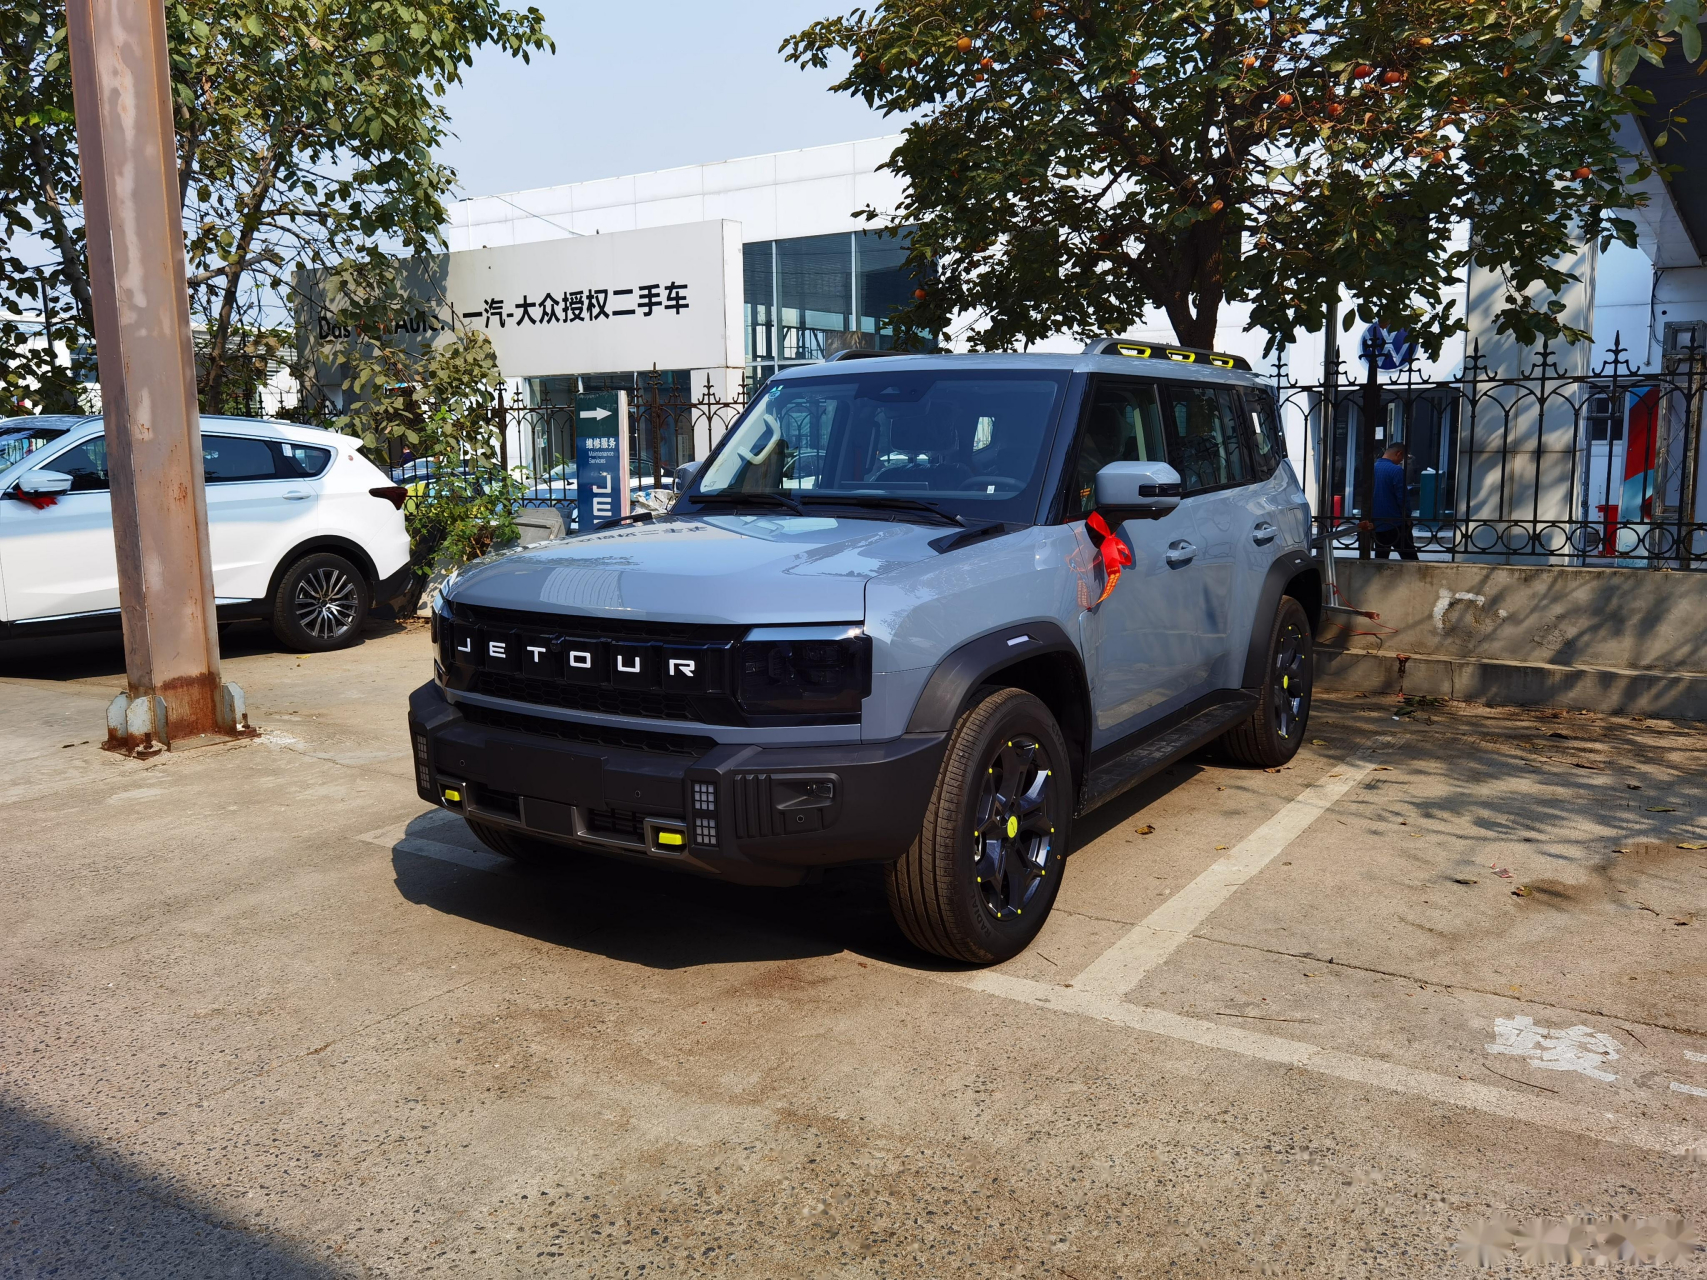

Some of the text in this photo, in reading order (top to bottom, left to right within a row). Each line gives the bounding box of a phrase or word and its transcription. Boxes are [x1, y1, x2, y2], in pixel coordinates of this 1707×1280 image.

[462, 281, 690, 329] 一汽-大众授权二手车
[318, 316, 351, 340] Das
[585, 437, 616, 449] 维修服务
[592, 474, 612, 524] JE
[457, 637, 695, 677] JETOUR
